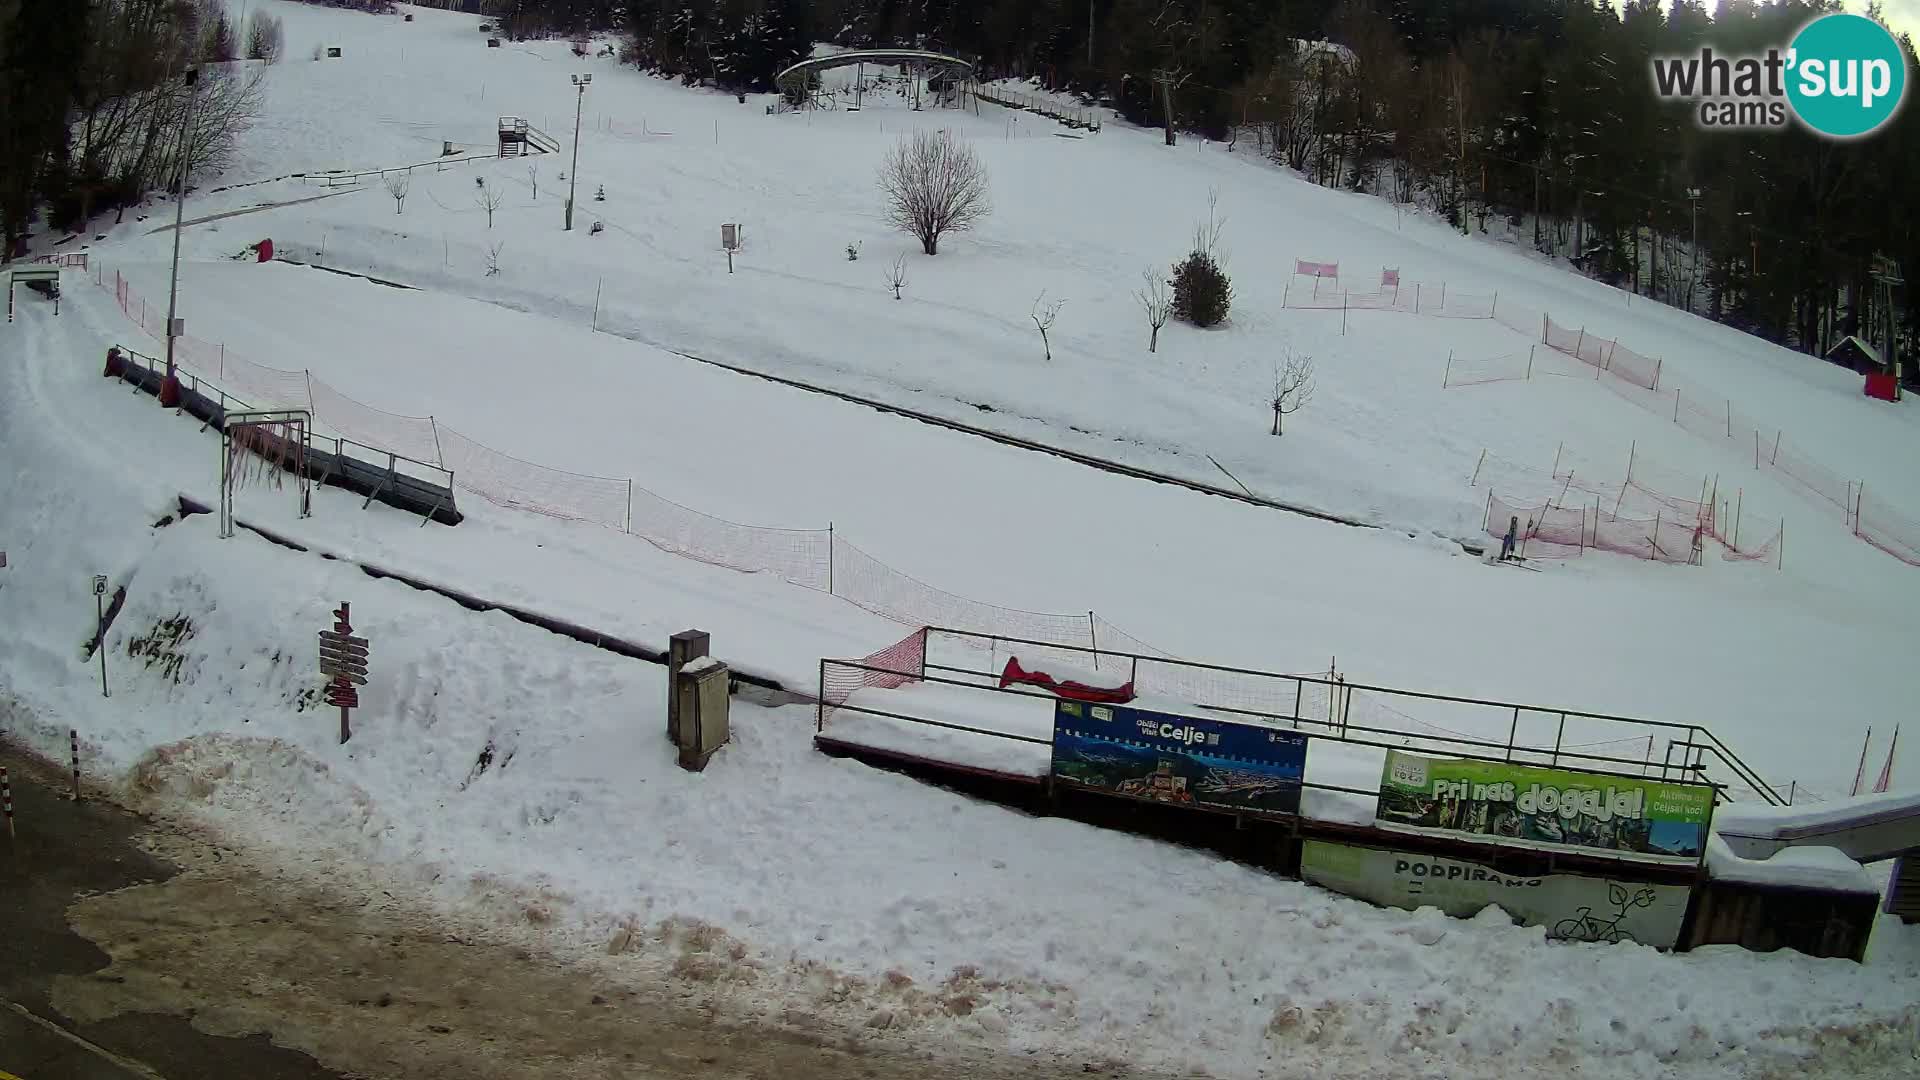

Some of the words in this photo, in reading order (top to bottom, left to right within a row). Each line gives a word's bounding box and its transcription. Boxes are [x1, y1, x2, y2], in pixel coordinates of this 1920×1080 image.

[1160, 723, 1205, 745] Celje
[1433, 778, 1468, 801] Pri
[1472, 781, 1515, 802] nas
[1516, 783, 1644, 822] dogaja!
